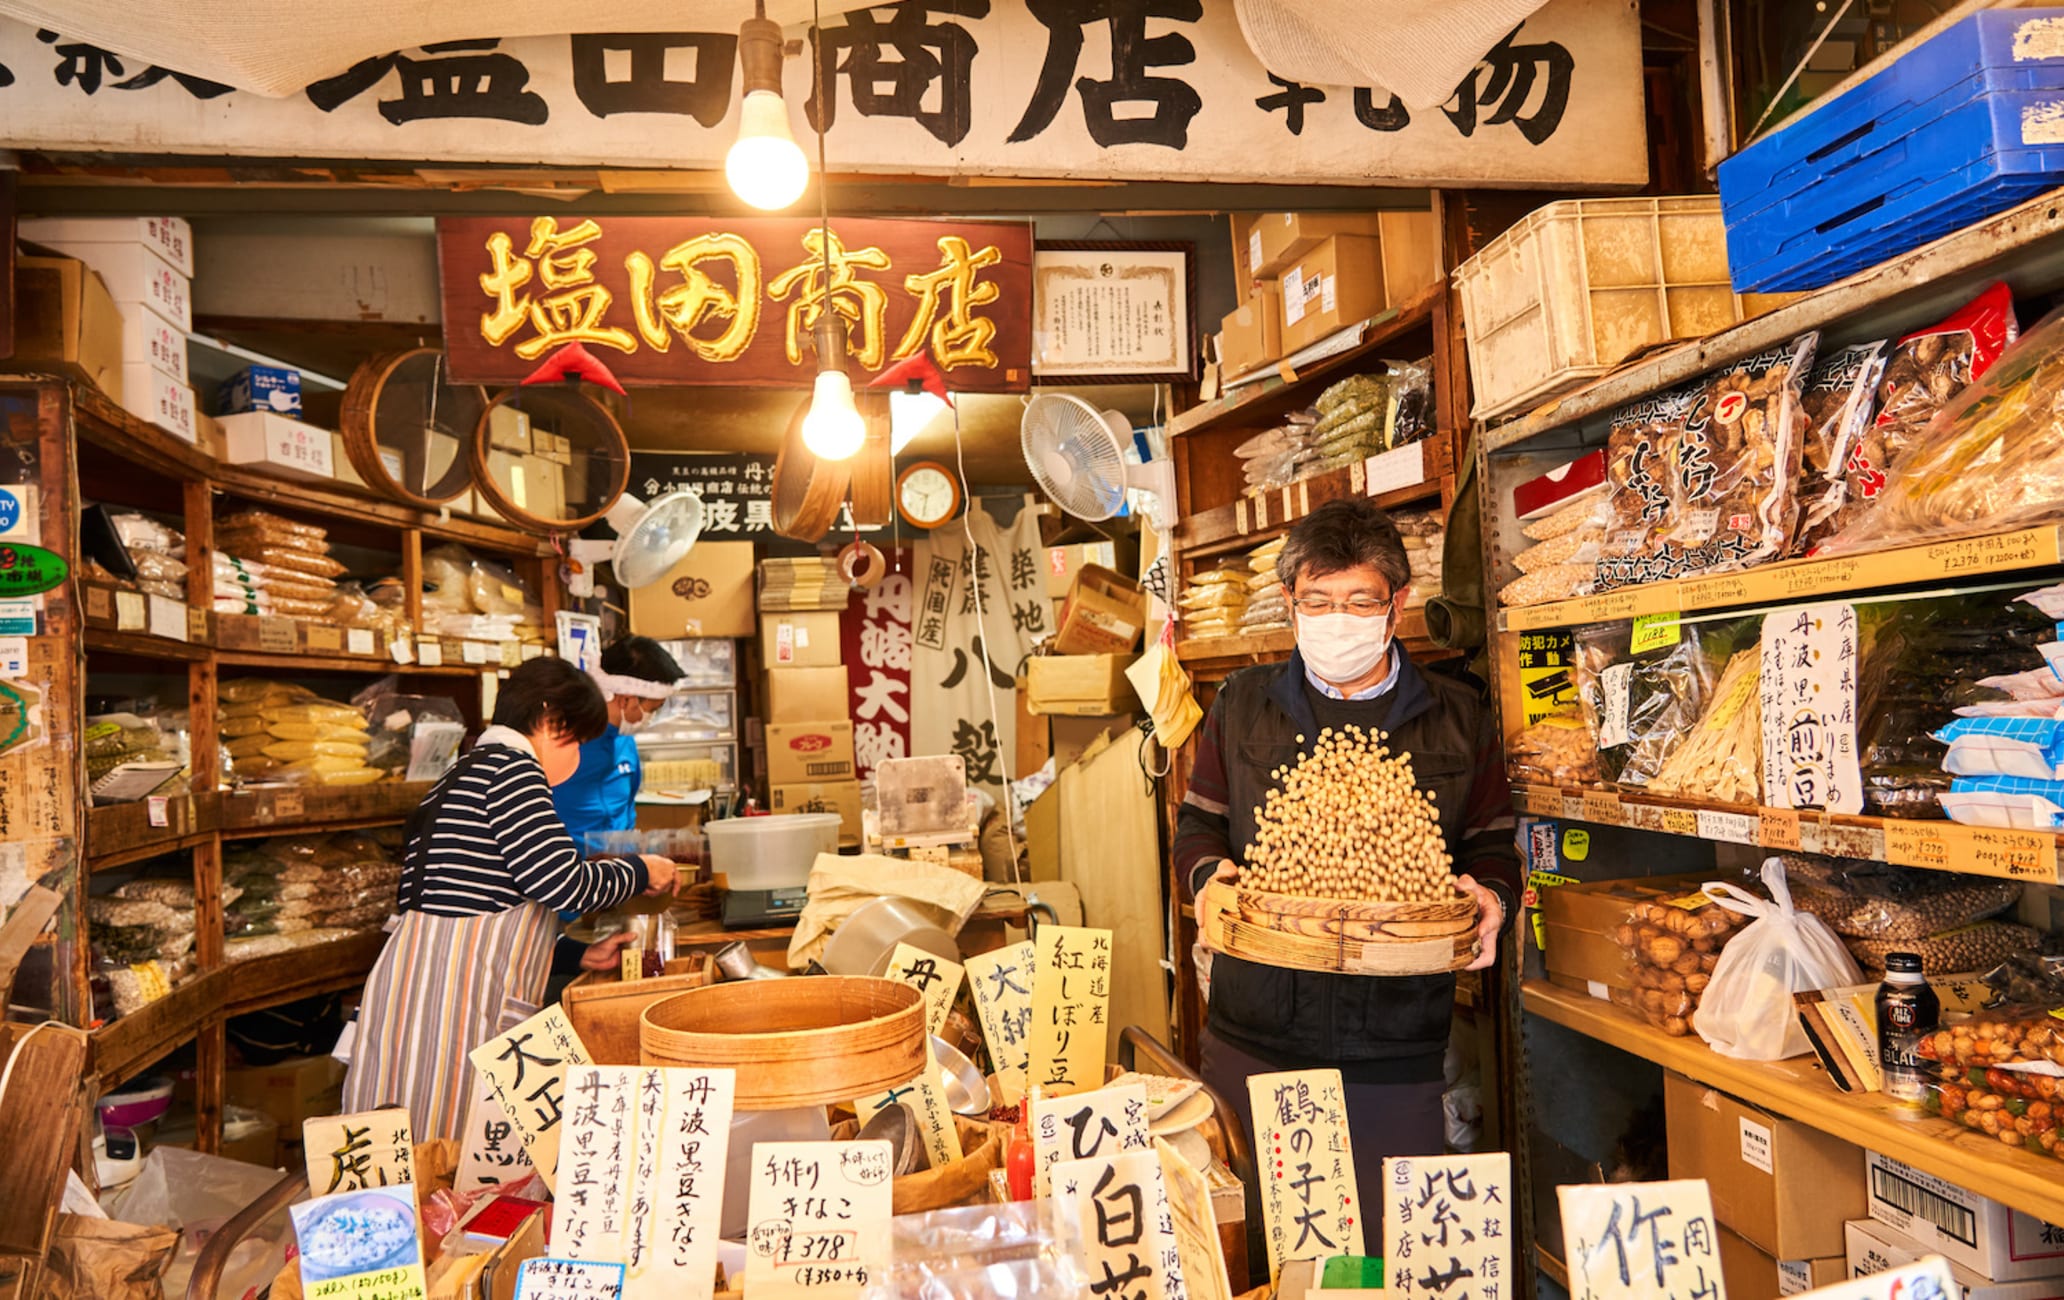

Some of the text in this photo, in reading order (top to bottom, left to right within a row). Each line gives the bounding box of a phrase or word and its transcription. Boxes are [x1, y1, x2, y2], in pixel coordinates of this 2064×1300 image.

[480, 215, 1001, 374] 塩田商店
[1681, 395, 1718, 503] しいたけ
[921, 562, 952, 645] 純国産
[1043, 934, 1085, 1087] 紅しぼり豆
[1089, 936, 1109, 1025] 北海道産
[564, 1070, 610, 1259] 丹波黒豆きなこ
[672, 1075, 716, 1267] 丹波黒豆きなこ
[765, 1154, 820, 1191] 手作り
[773, 1196, 852, 1224] きなこ
[783, 1234, 845, 1262] ¥378
[1394, 1196, 1415, 1300] 当店特
